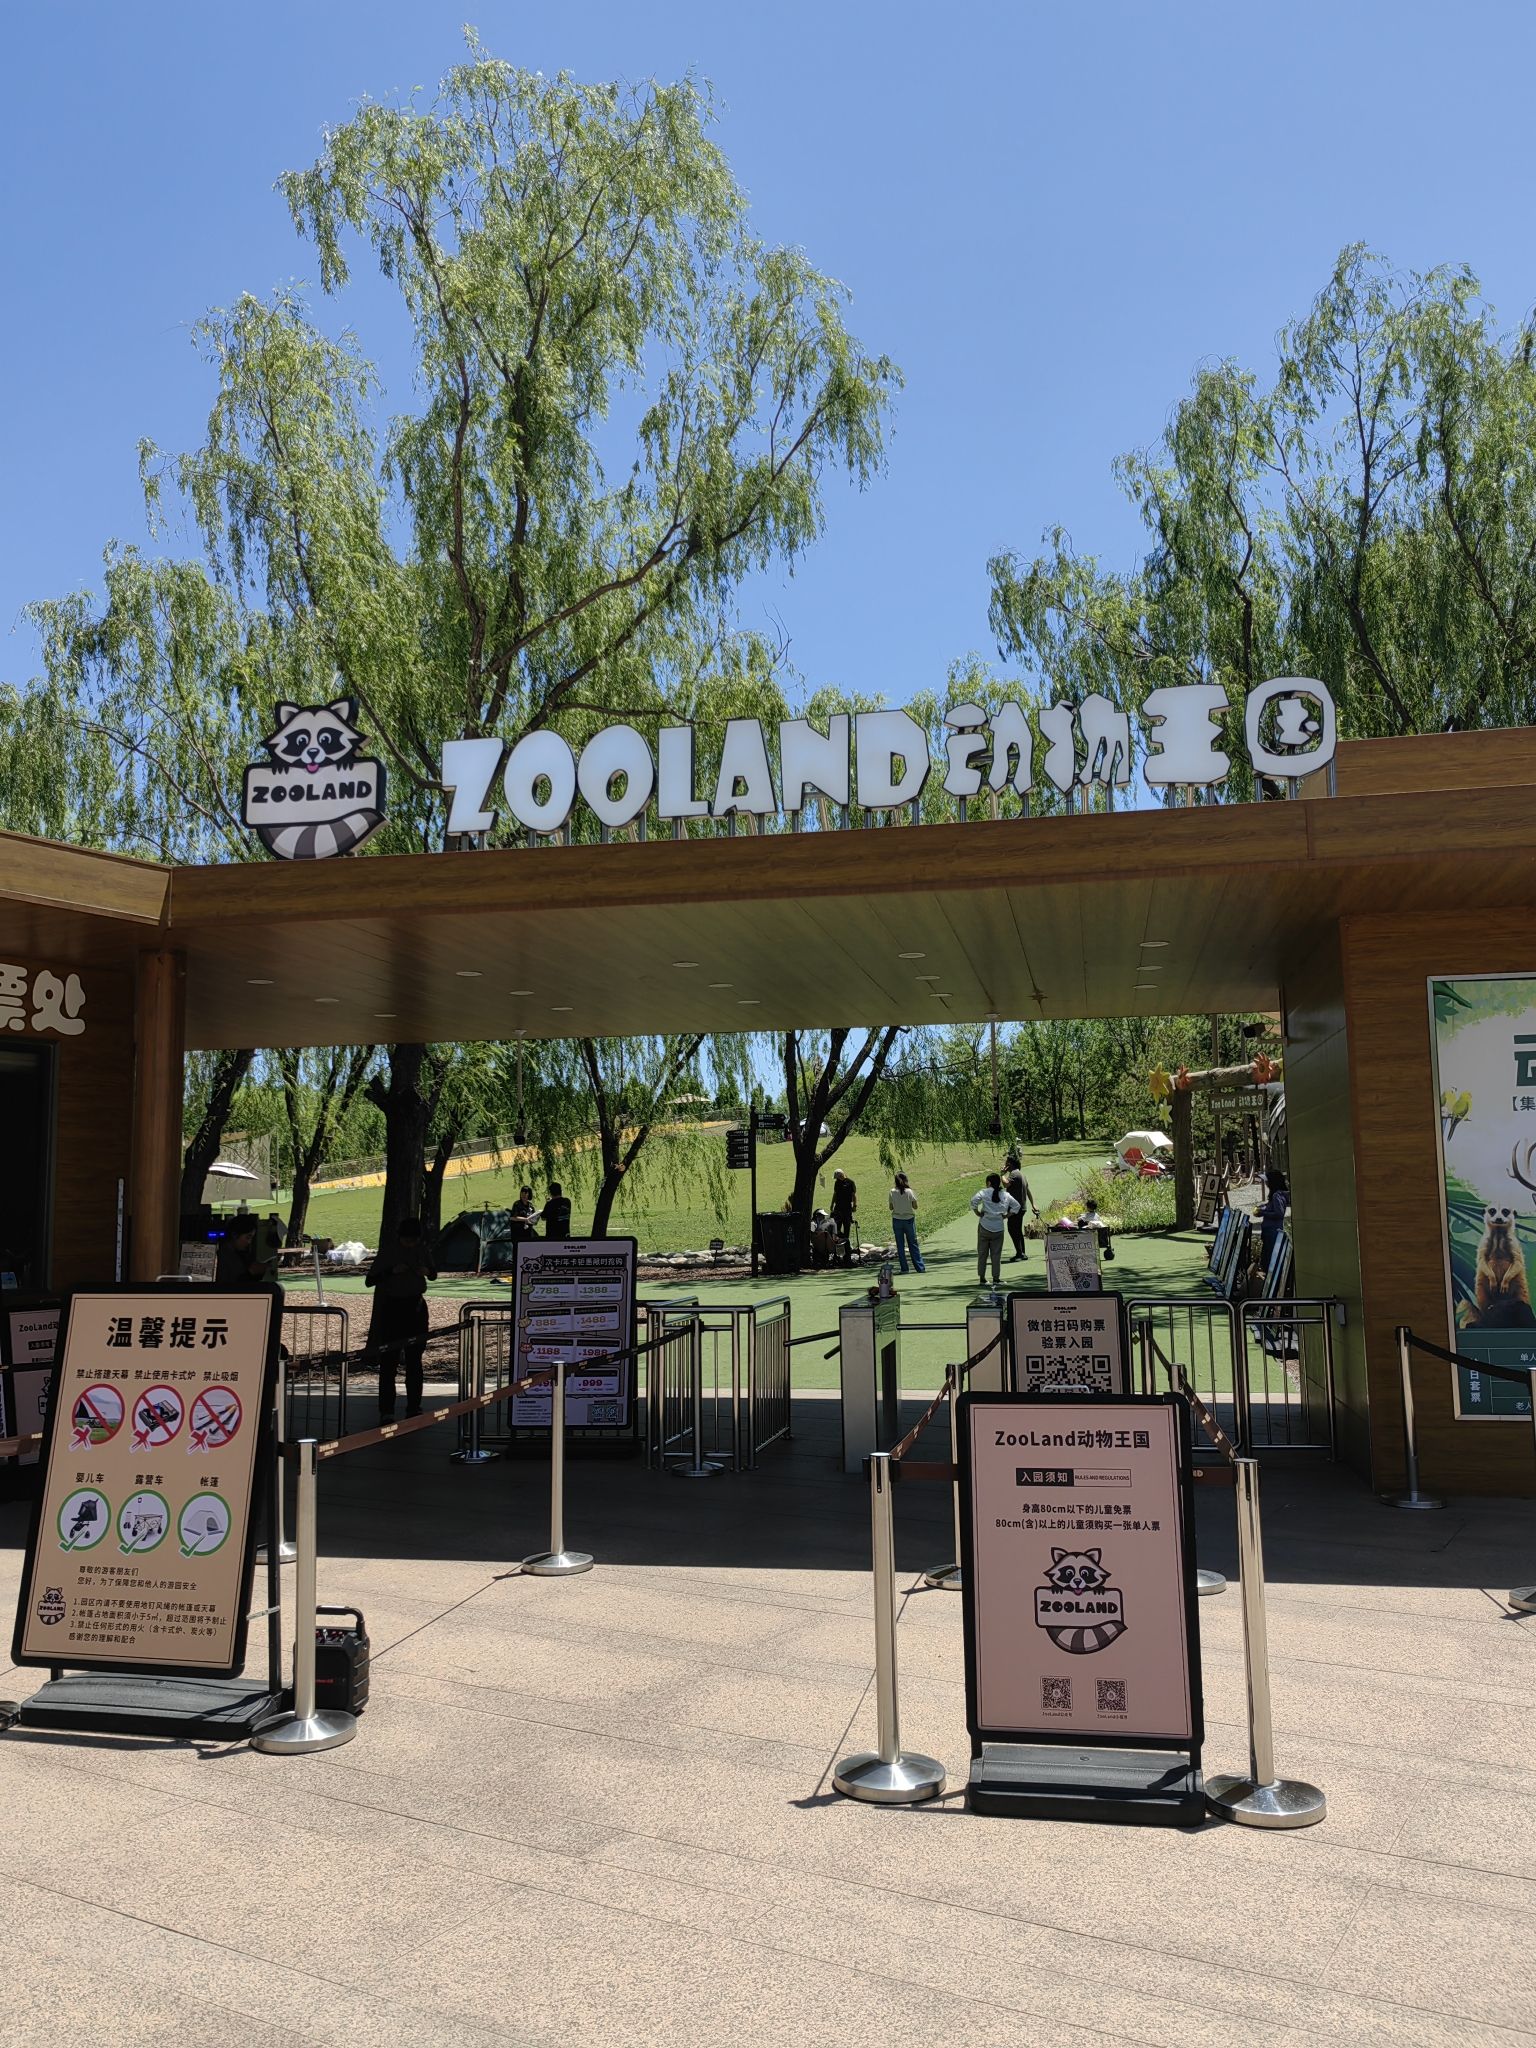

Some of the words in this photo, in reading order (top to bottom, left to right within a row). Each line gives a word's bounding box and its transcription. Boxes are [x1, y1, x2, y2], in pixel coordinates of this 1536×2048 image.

[442, 708, 931, 836] ZOOLAND
[942, 676, 1337, 797] 动物王国
[251, 779, 373, 803] ZOOLAND
[1027, 1319, 1106, 1333] 微信扫码购票
[106, 1317, 229, 1349] 温馨提示
[1041, 1336, 1094, 1349] 验票入园
[76, 1369, 129, 1380] 禁止搭建天幕
[134, 1370, 197, 1381] 禁止使用卡式炉
[203, 1371, 240, 1382] 禁止吸烟
[995, 1430, 1150, 1449] ZooLand动物王国
[75, 1472, 105, 1484] 婴儿车
[134, 1474, 164, 1486] 露营车
[1021, 1471, 1068, 1483] 入园须知
[1022, 1503, 1132, 1516] 身高80cm以下的儿童免票
[79, 1565, 139, 1577] 尊敬的游客朋友们
[1039, 1600, 1119, 1615] ZOOLAND
[68, 1632, 136, 1644] 感谢您的理解和配合
